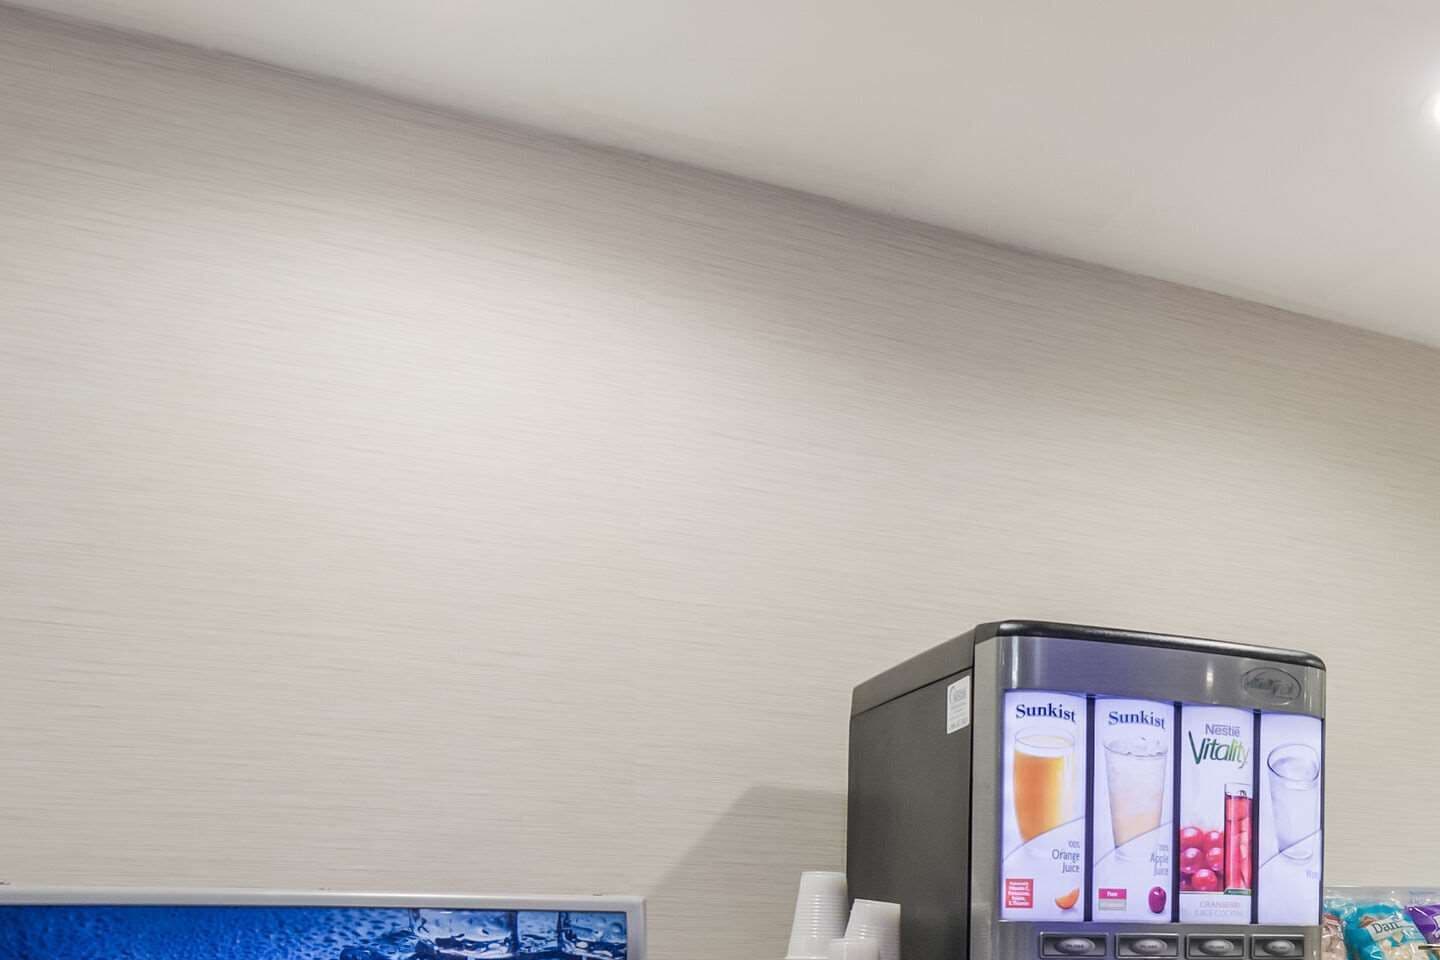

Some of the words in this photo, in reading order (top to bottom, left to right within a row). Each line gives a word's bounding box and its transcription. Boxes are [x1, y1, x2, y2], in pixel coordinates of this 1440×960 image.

[1015, 703, 1076, 723] Sunkist
[1108, 710, 1165, 729] Sunkist
[1188, 730, 1249, 769] Vitality
[1051, 849, 1080, 863] Orange
[1062, 863, 1080, 873] Juice
